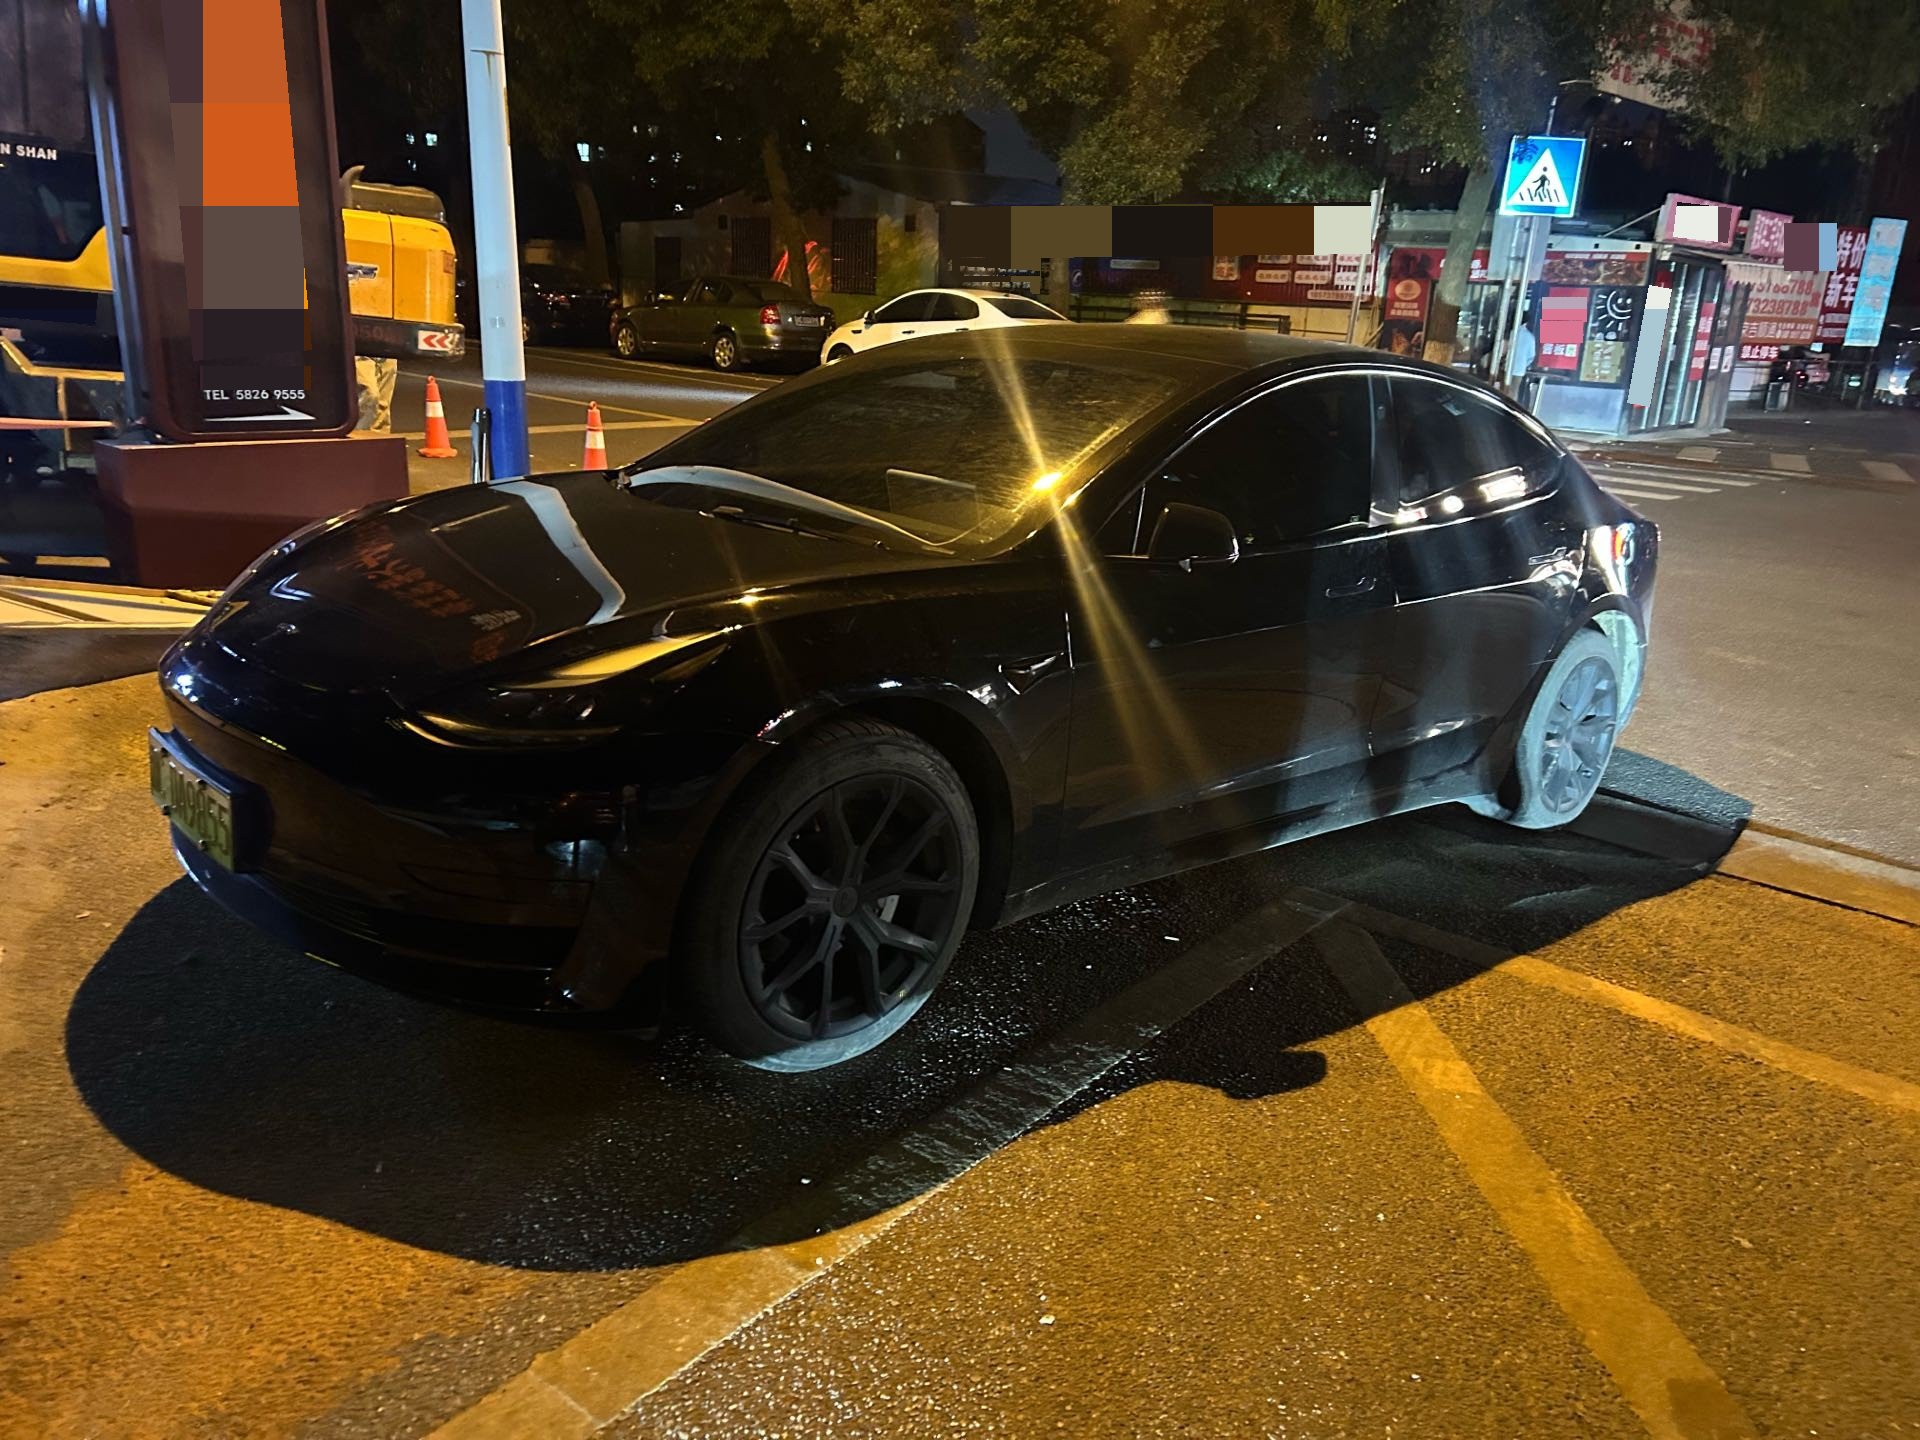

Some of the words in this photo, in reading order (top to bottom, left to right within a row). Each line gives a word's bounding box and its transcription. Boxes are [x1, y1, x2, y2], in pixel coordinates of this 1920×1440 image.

[15, 144, 57, 161] SHAN
[203, 389, 230, 401] TEL
[235, 389, 270, 400] 5826
[273, 389, 306, 400] 9555
